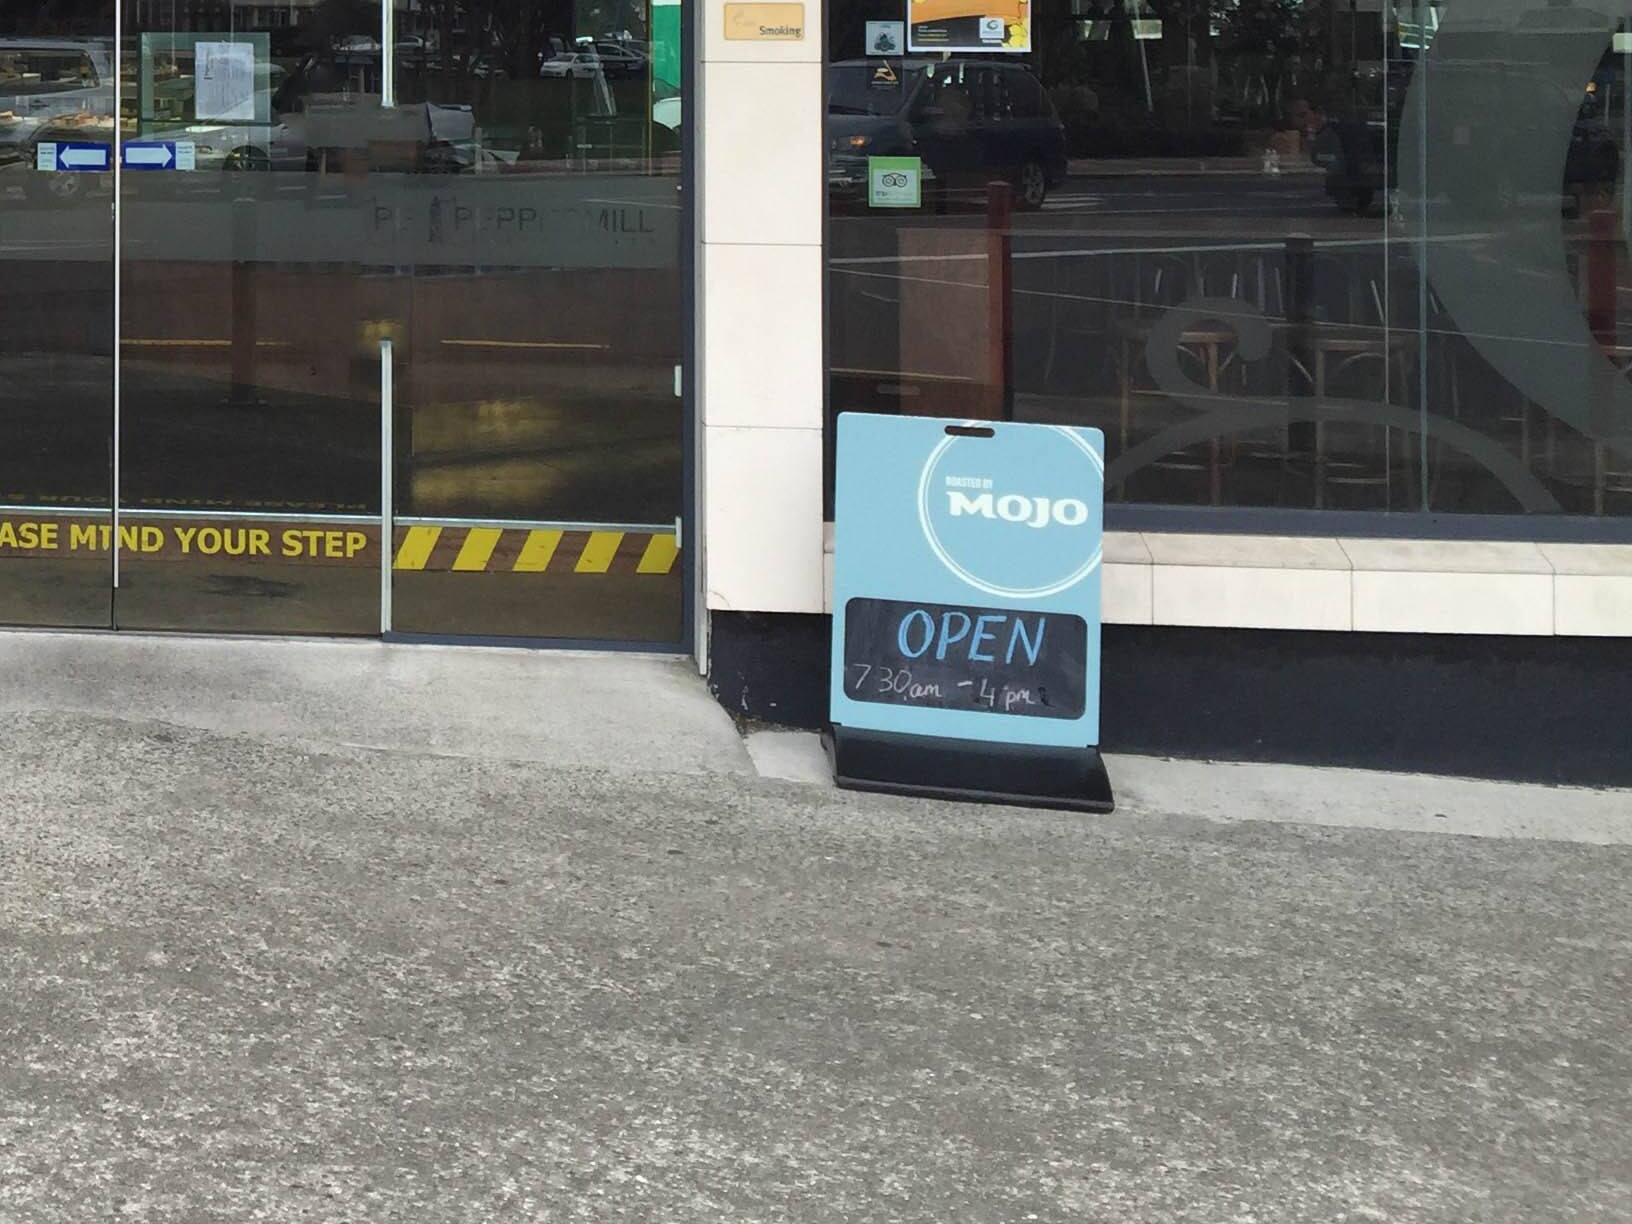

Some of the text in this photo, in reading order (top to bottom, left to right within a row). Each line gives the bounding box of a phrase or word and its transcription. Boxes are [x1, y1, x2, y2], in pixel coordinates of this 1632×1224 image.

[759, 25, 801, 38] Smoking
[946, 491, 1088, 528] MOJO
[70, 523, 164, 553] MIND
[174, 527, 272, 556] YOUR
[282, 529, 367, 558] STEP
[897, 609, 1046, 666] OPEN
